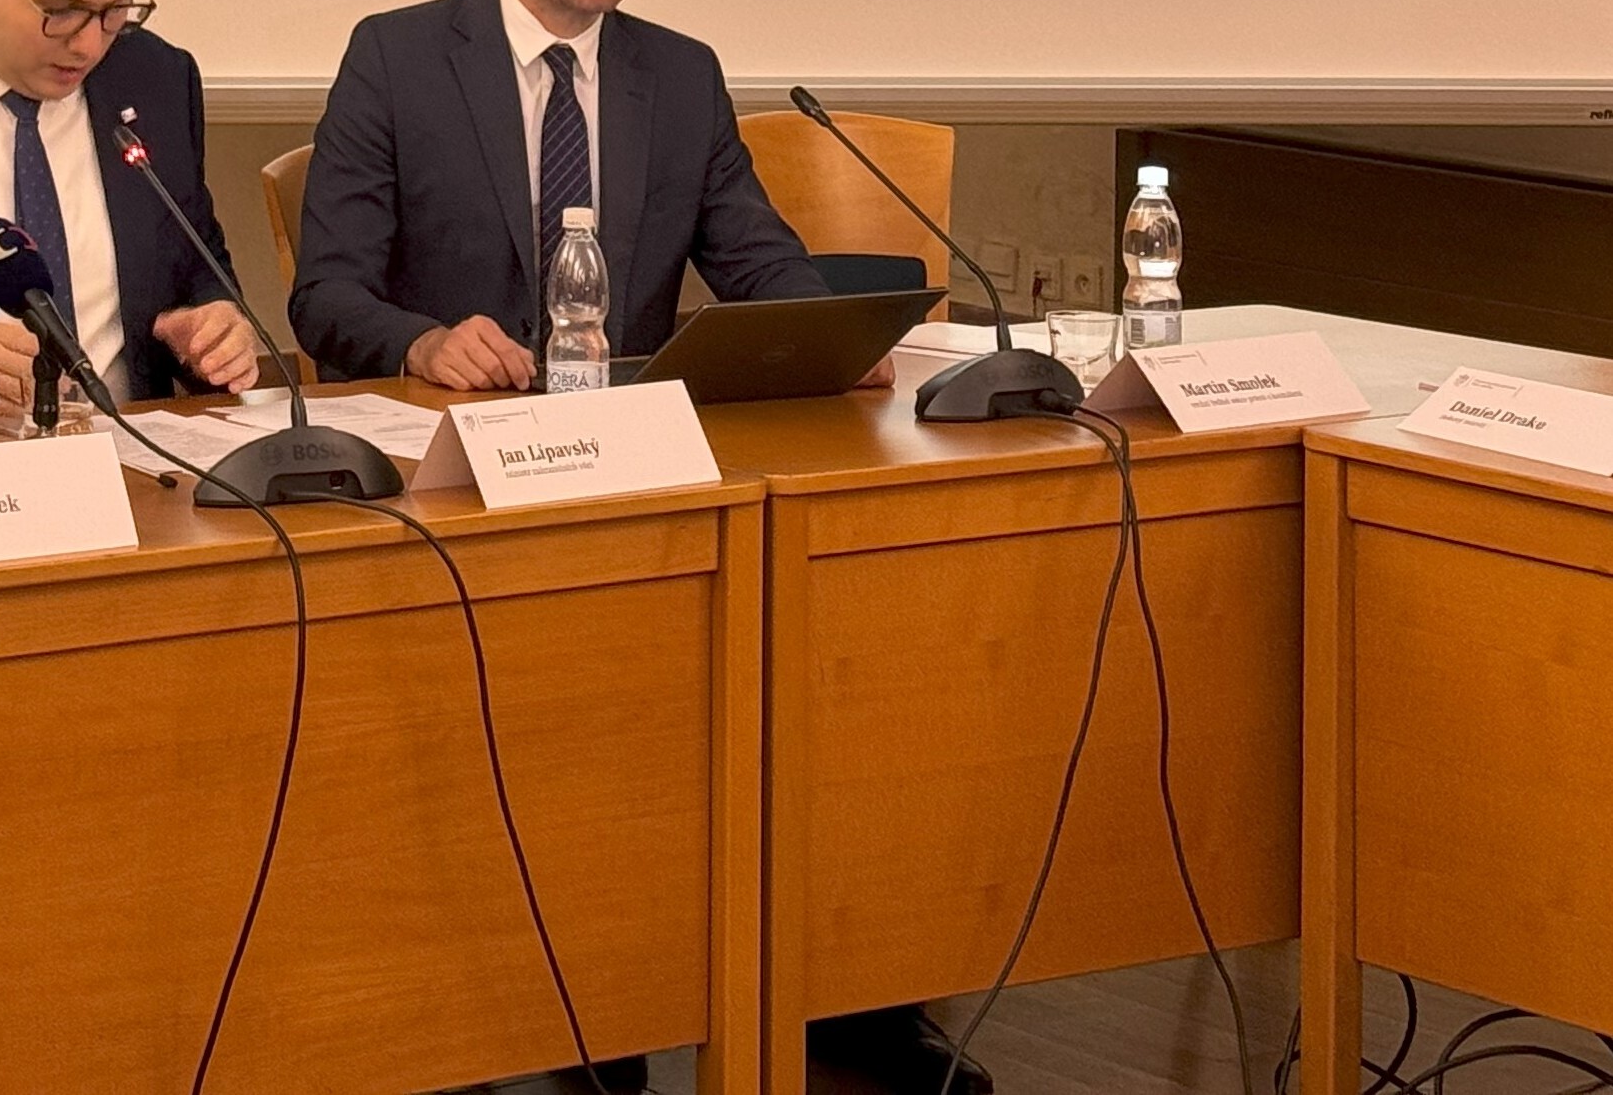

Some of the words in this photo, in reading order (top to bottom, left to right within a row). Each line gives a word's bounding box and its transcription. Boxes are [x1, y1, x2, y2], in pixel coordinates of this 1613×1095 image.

[1179, 380, 1230, 398] Martin
[1226, 373, 1282, 393] Smolek
[1448, 400, 1503, 421] Daniel
[1497, 410, 1547, 431] Drake
[497, 448, 528, 468] Jan
[527, 437, 601, 464] Lipavský
